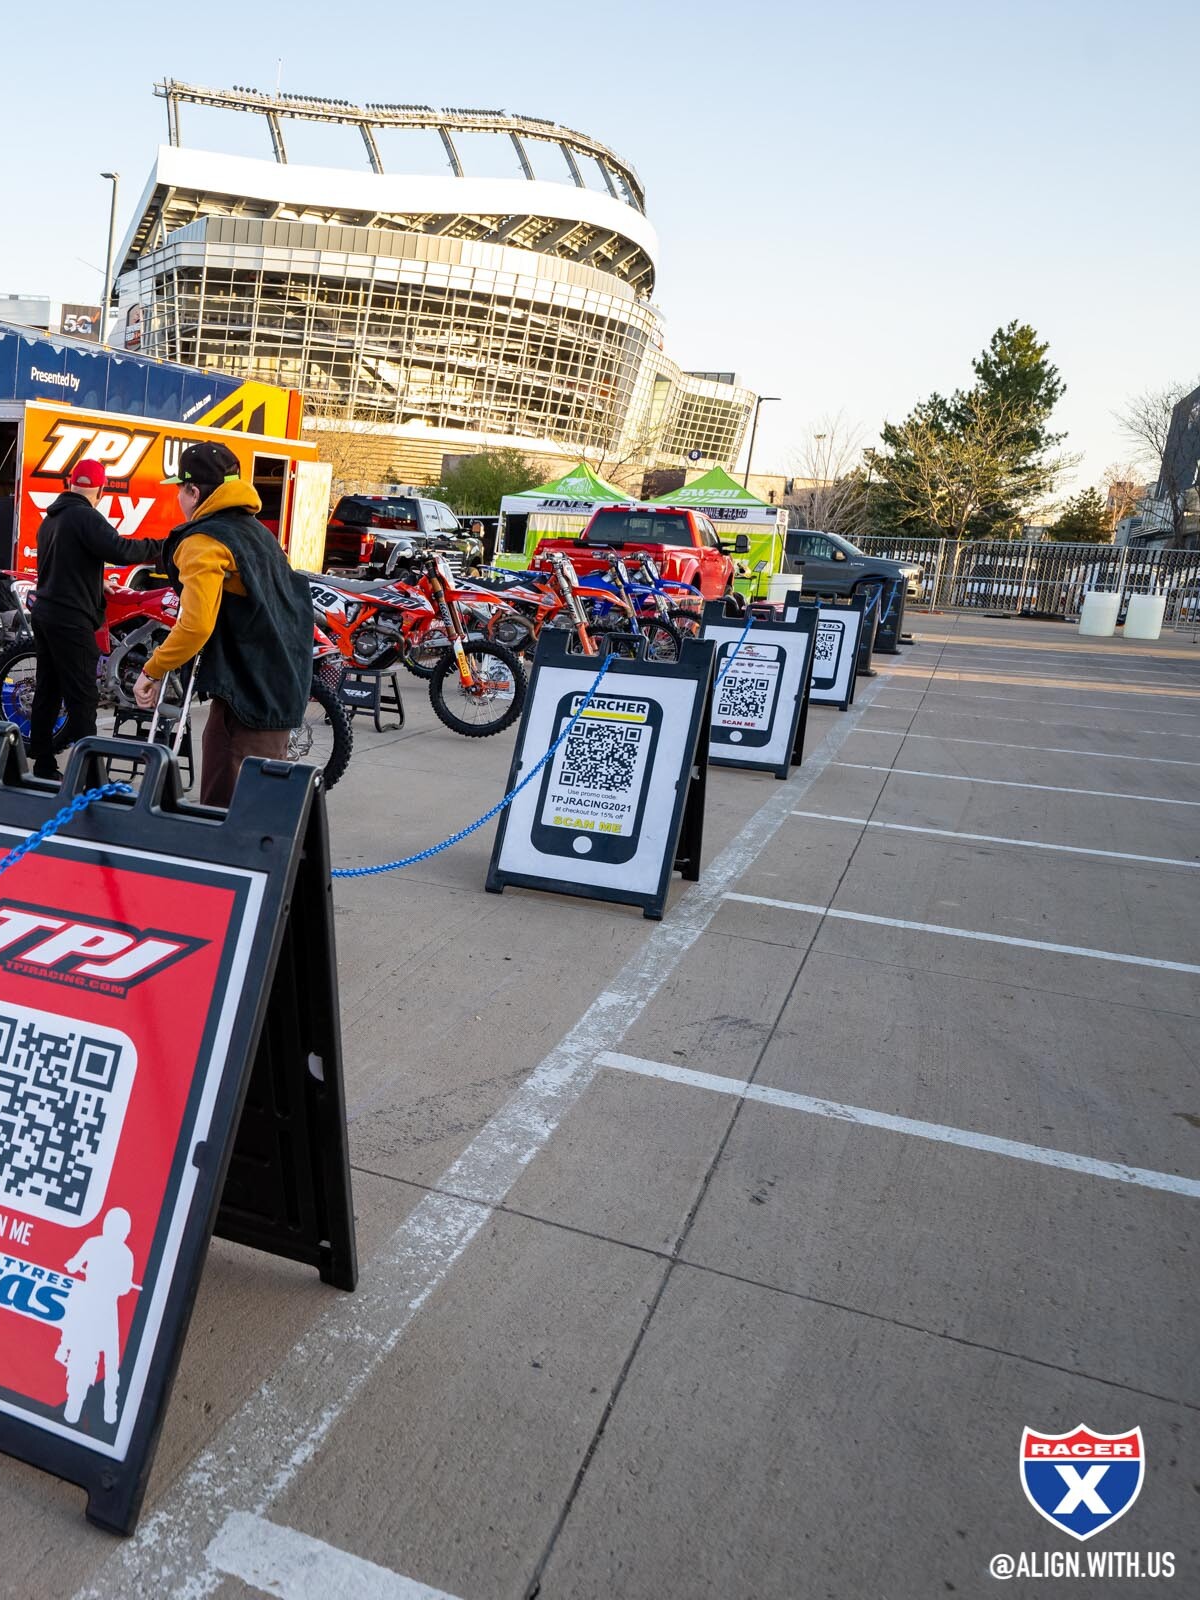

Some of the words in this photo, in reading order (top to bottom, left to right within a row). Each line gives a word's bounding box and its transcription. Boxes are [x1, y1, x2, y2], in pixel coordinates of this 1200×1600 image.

[31, 366, 69, 386] Presented
[70, 373, 80, 391] by
[38, 424, 156, 478] TPJ
[537, 500, 595, 509] JONES
[343, 688, 371, 698] FLY
[574, 698, 647, 713] KÄRCHER
[551, 795, 631, 812] TPJRACING2021
[581, 791, 600, 799] promo
[565, 807, 589, 815] checkout
[553, 816, 594, 830] SCAN
[599, 822, 622, 833] ME
[6, 960, 126, 996] TPJRACING.COM
[9, 1219, 34, 1246] ME
[3, 1256, 74, 1289] TYRES
